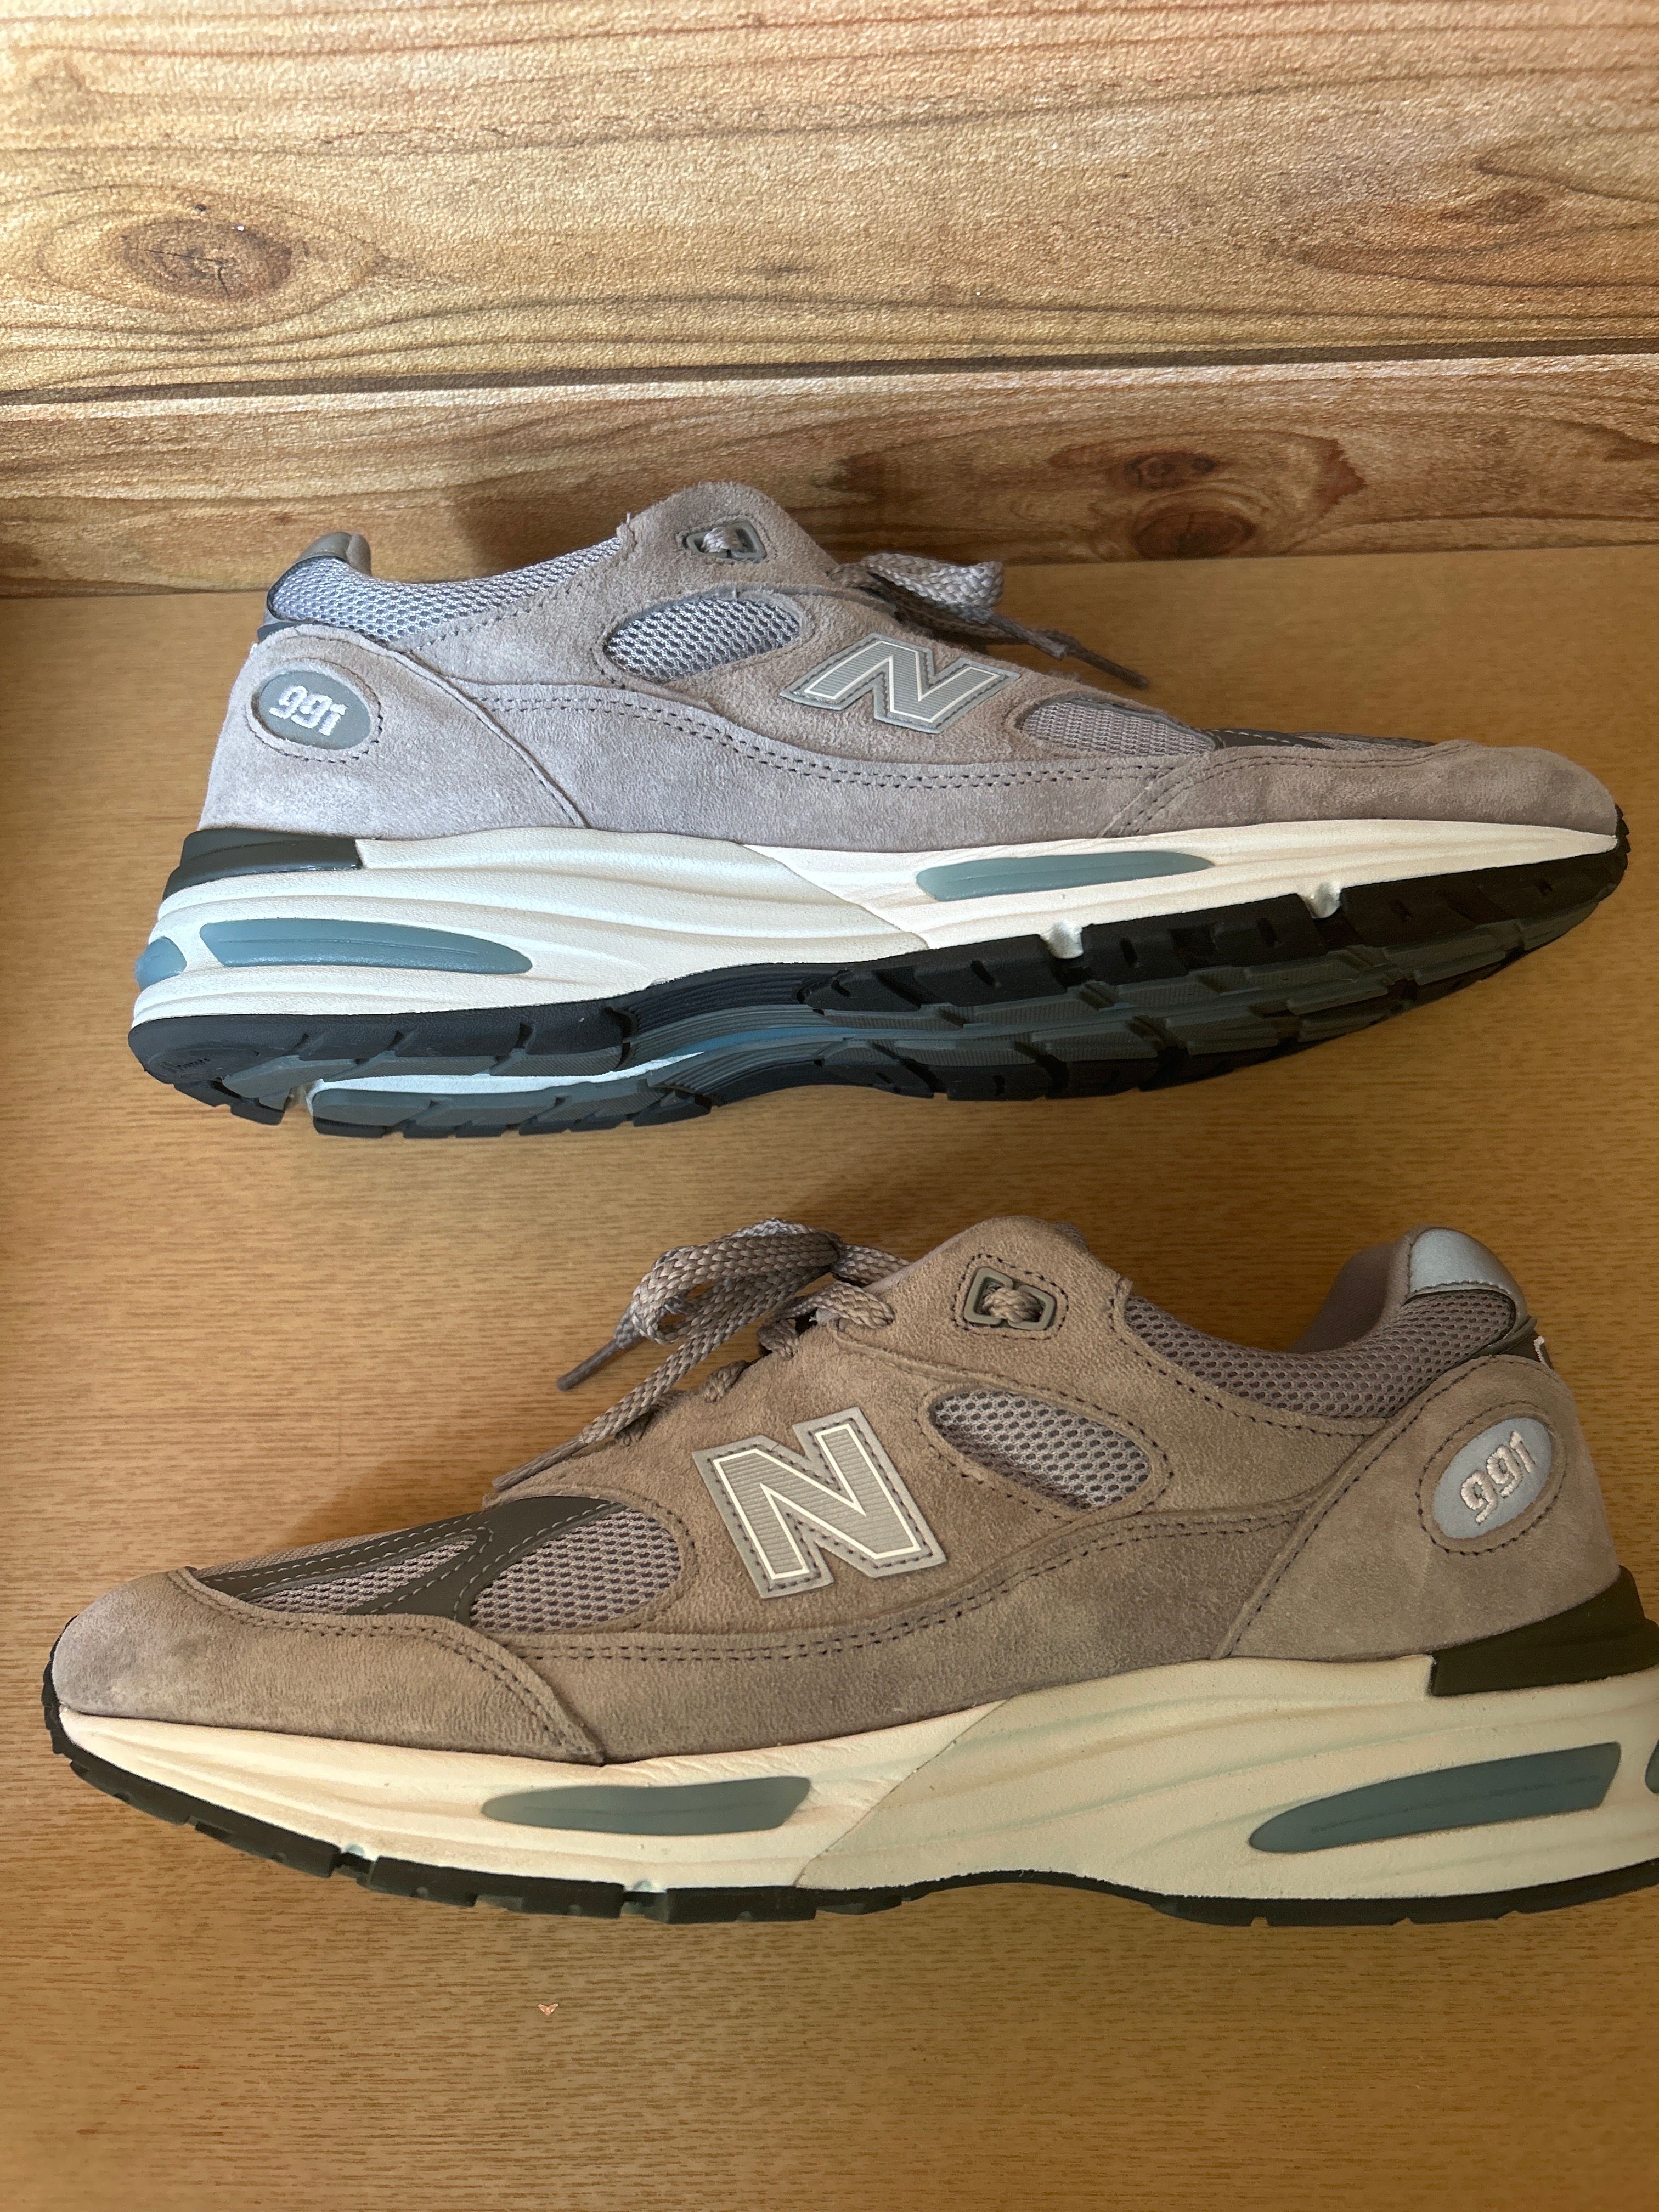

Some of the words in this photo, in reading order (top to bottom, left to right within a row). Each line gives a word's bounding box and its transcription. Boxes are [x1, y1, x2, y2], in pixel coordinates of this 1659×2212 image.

[269, 685, 348, 736] 991
[779, 632, 1022, 735] N
[691, 1406, 947, 1600] N
[1460, 1430, 1536, 1525] 991
